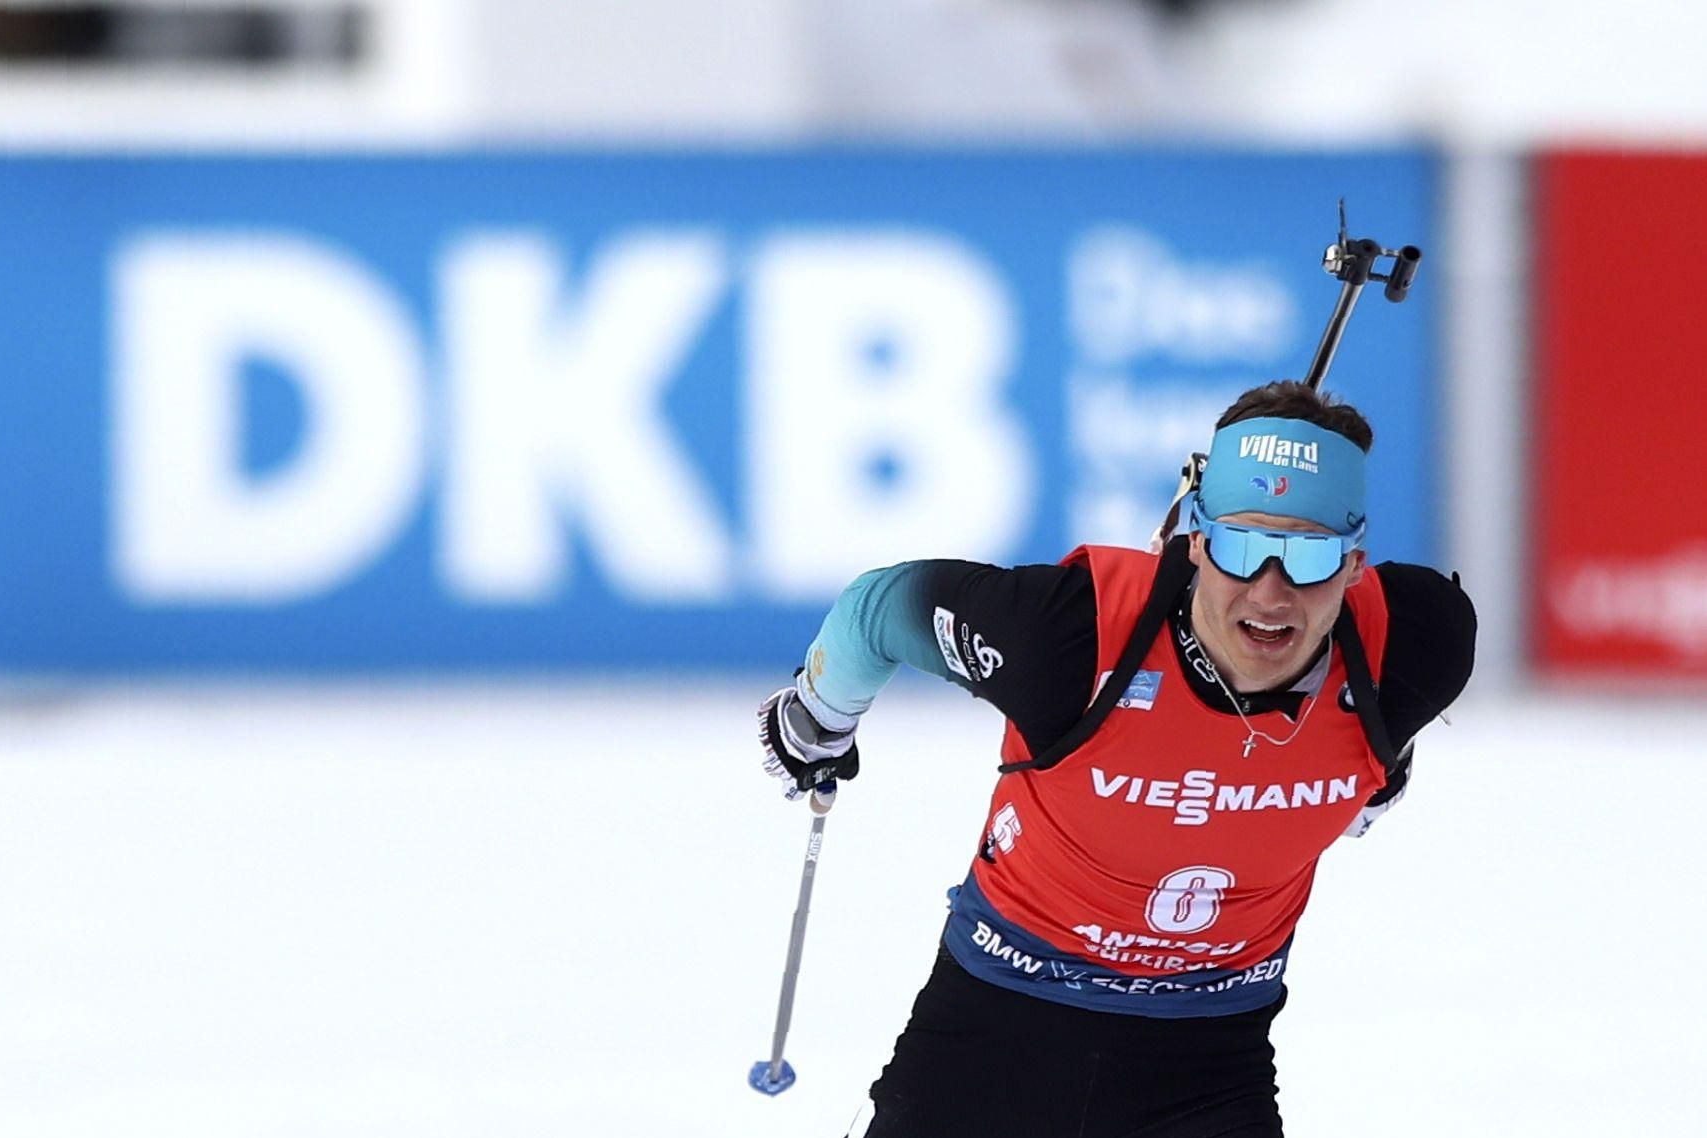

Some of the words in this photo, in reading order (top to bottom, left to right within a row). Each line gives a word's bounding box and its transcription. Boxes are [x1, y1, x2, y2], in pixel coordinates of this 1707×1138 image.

[106, 226, 1040, 606] DKB
[1239, 434, 1318, 463] Villard
[1090, 767, 1359, 827] VIESSMANN
[1145, 865, 1236, 935] 6
[970, 920, 1044, 975] BMW
